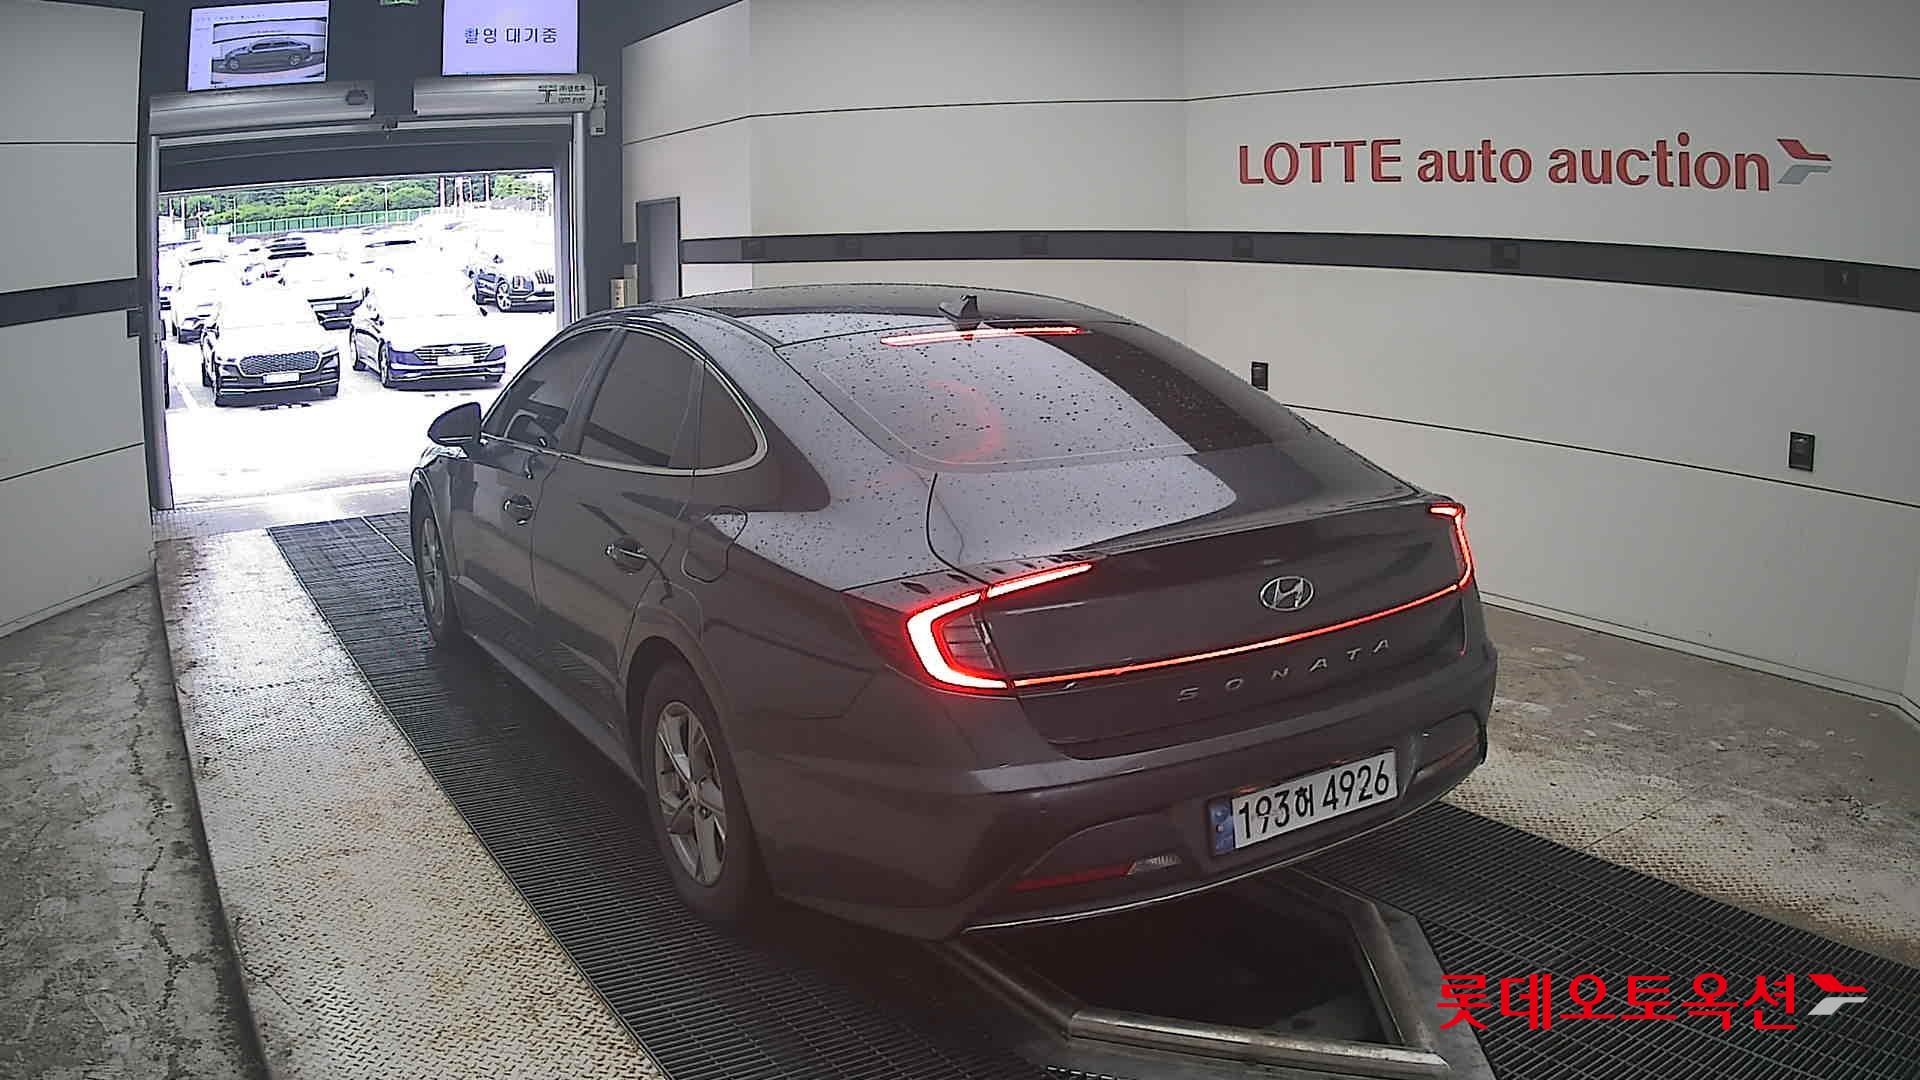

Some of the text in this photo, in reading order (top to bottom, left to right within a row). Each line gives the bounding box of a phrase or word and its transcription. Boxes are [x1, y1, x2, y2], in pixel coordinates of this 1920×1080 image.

[505, 27, 558, 45] 대기중
[1239, 132, 1771, 192] LOTTE auto auction
[1177, 640, 1389, 701] SONATA
[1239, 760, 1389, 839] 193허 4926
